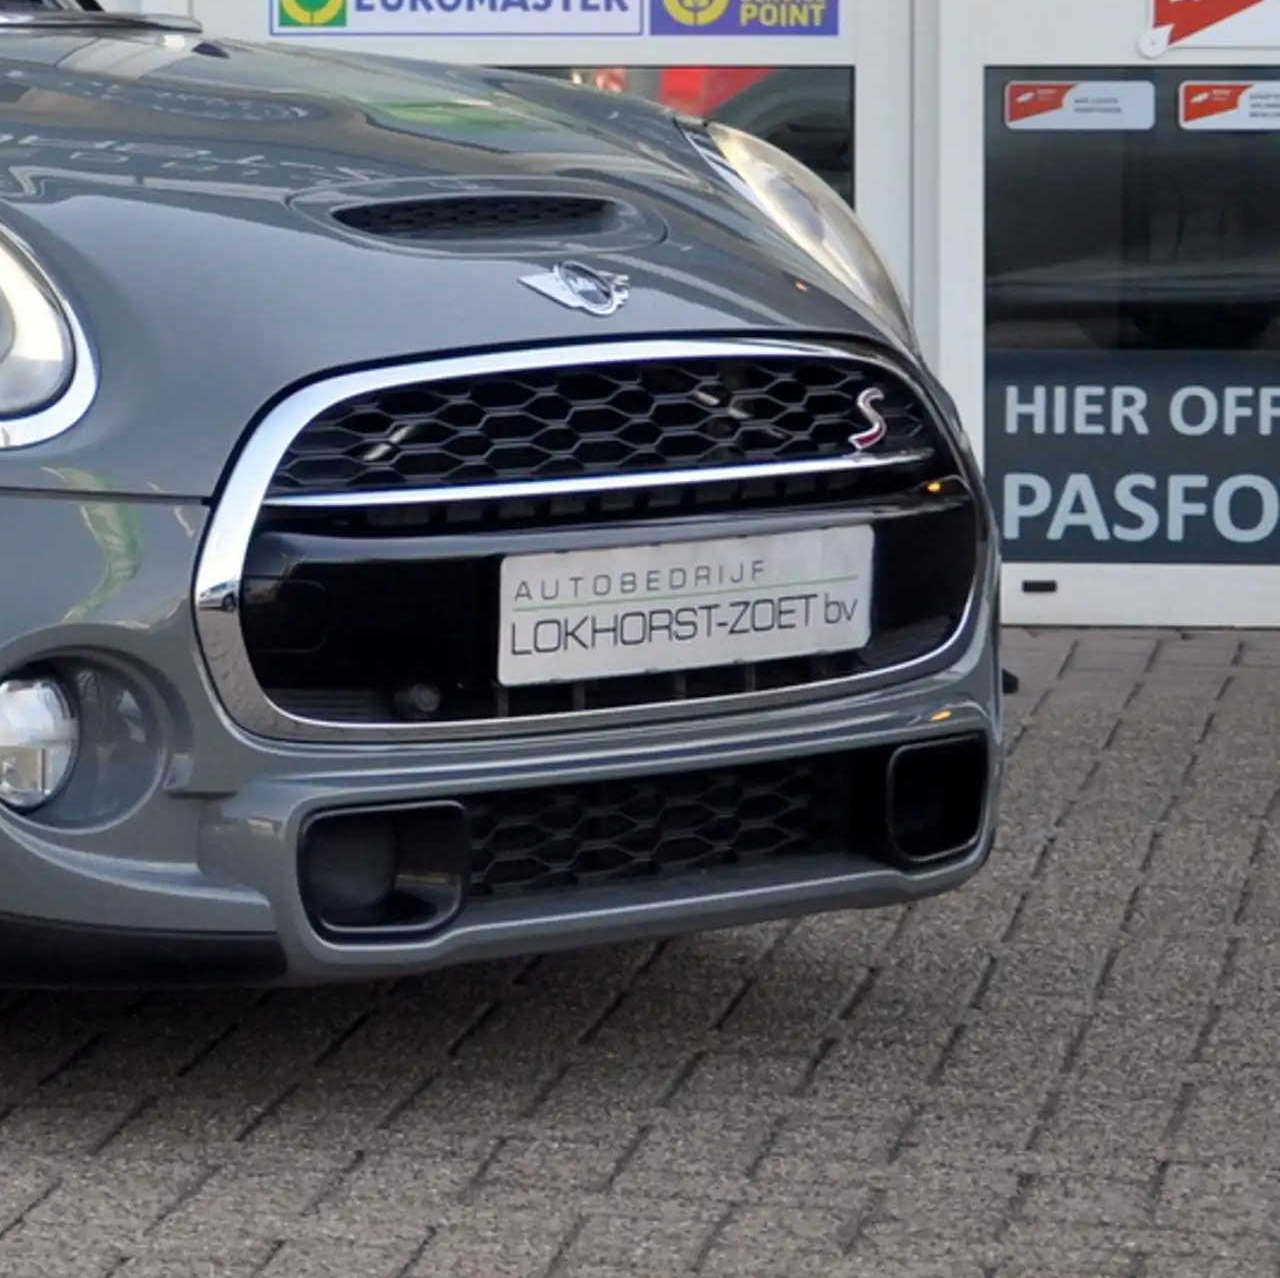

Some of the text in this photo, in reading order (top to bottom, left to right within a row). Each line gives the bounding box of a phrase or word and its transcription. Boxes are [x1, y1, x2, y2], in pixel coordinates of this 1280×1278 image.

[741, 3, 826, 27] POINT
[1005, 385, 1149, 435] HIER
[1002, 472, 1280, 543] PASFO
[514, 560, 766, 602] AUTOBEDRIJF
[510, 593, 859, 656] LOKHORST-ZOET bv
